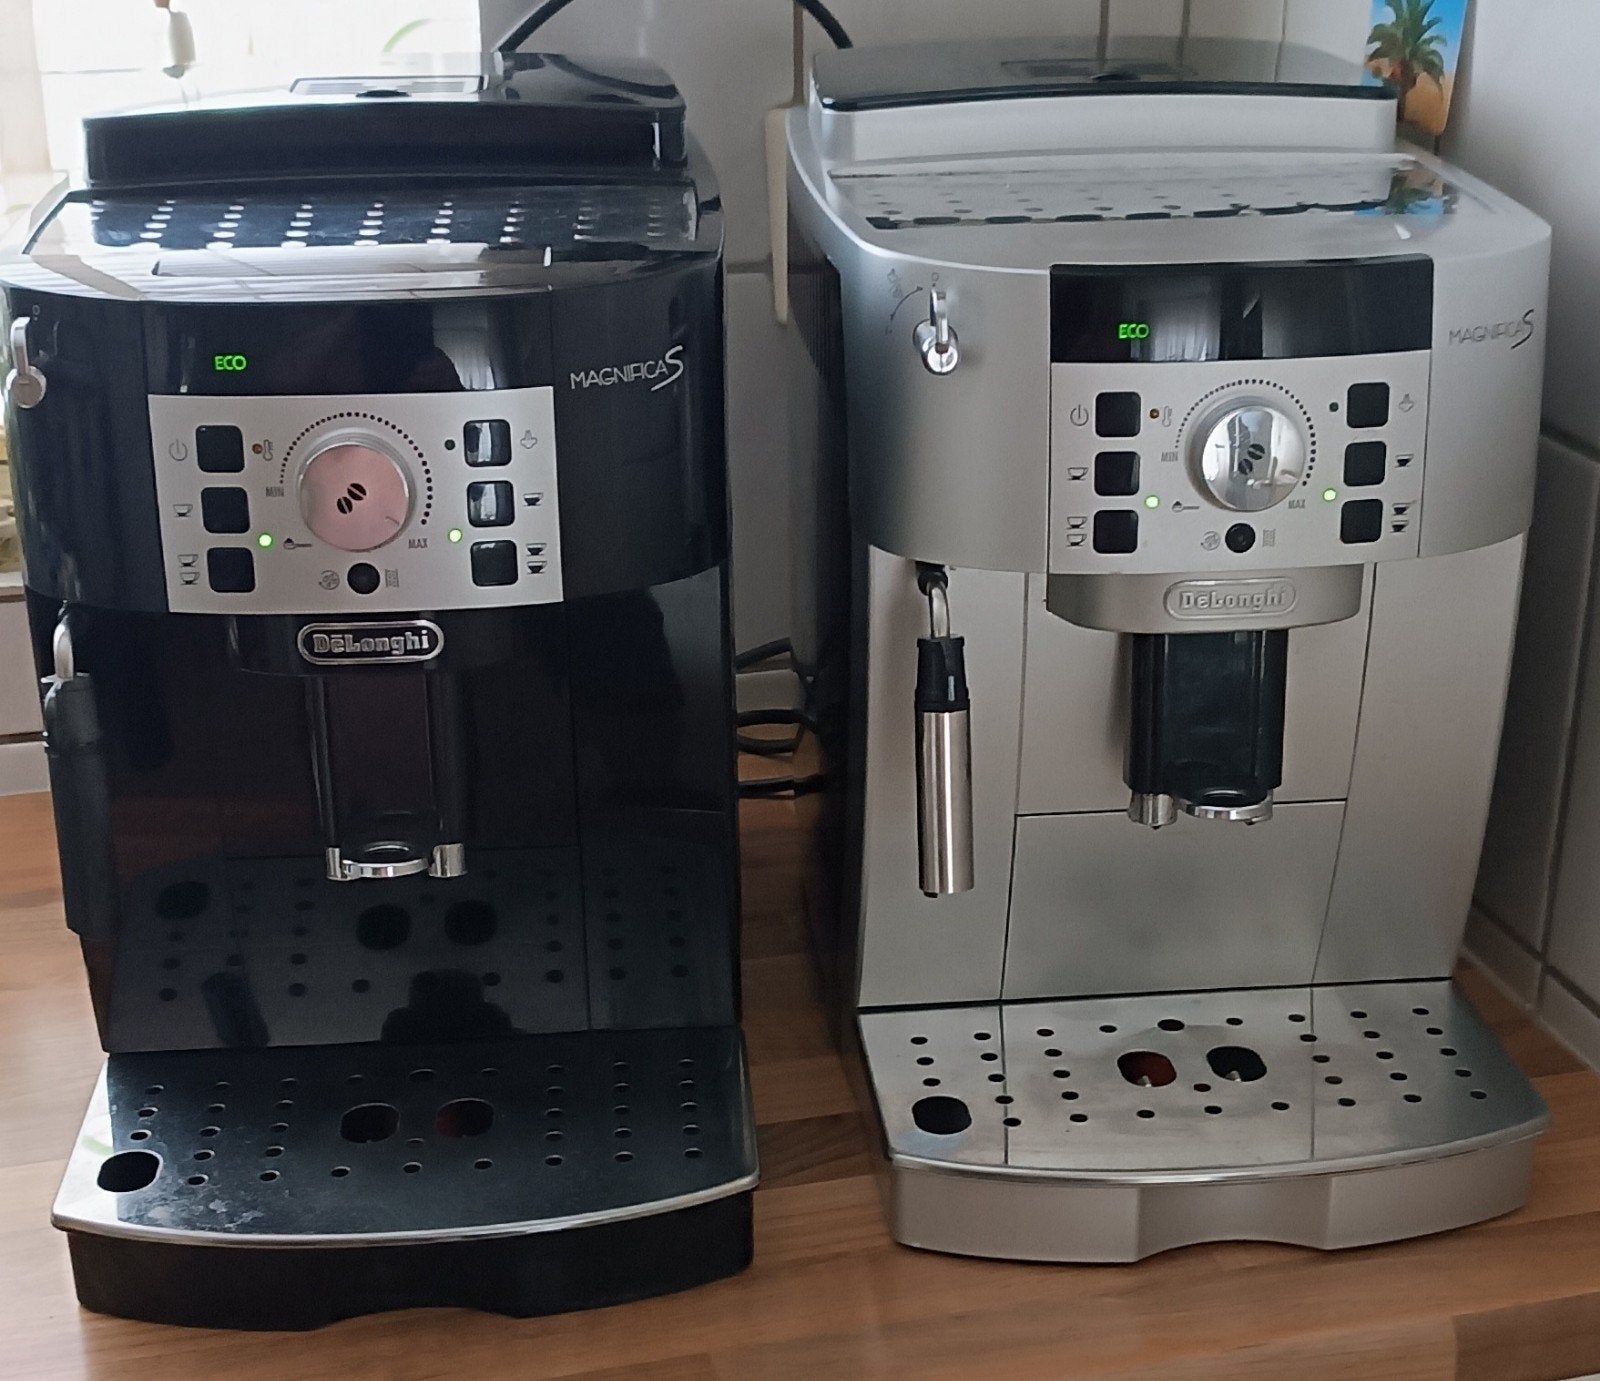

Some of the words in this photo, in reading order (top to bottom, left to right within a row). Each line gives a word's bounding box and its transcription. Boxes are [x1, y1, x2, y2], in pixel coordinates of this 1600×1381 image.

[1119, 323, 1150, 339] ECO
[214, 355, 247, 370] ECO
[1160, 451, 1179, 462] MIN
[265, 486, 285, 498] MIN
[1288, 499, 1306, 510] MAX
[408, 537, 428, 549] MAX
